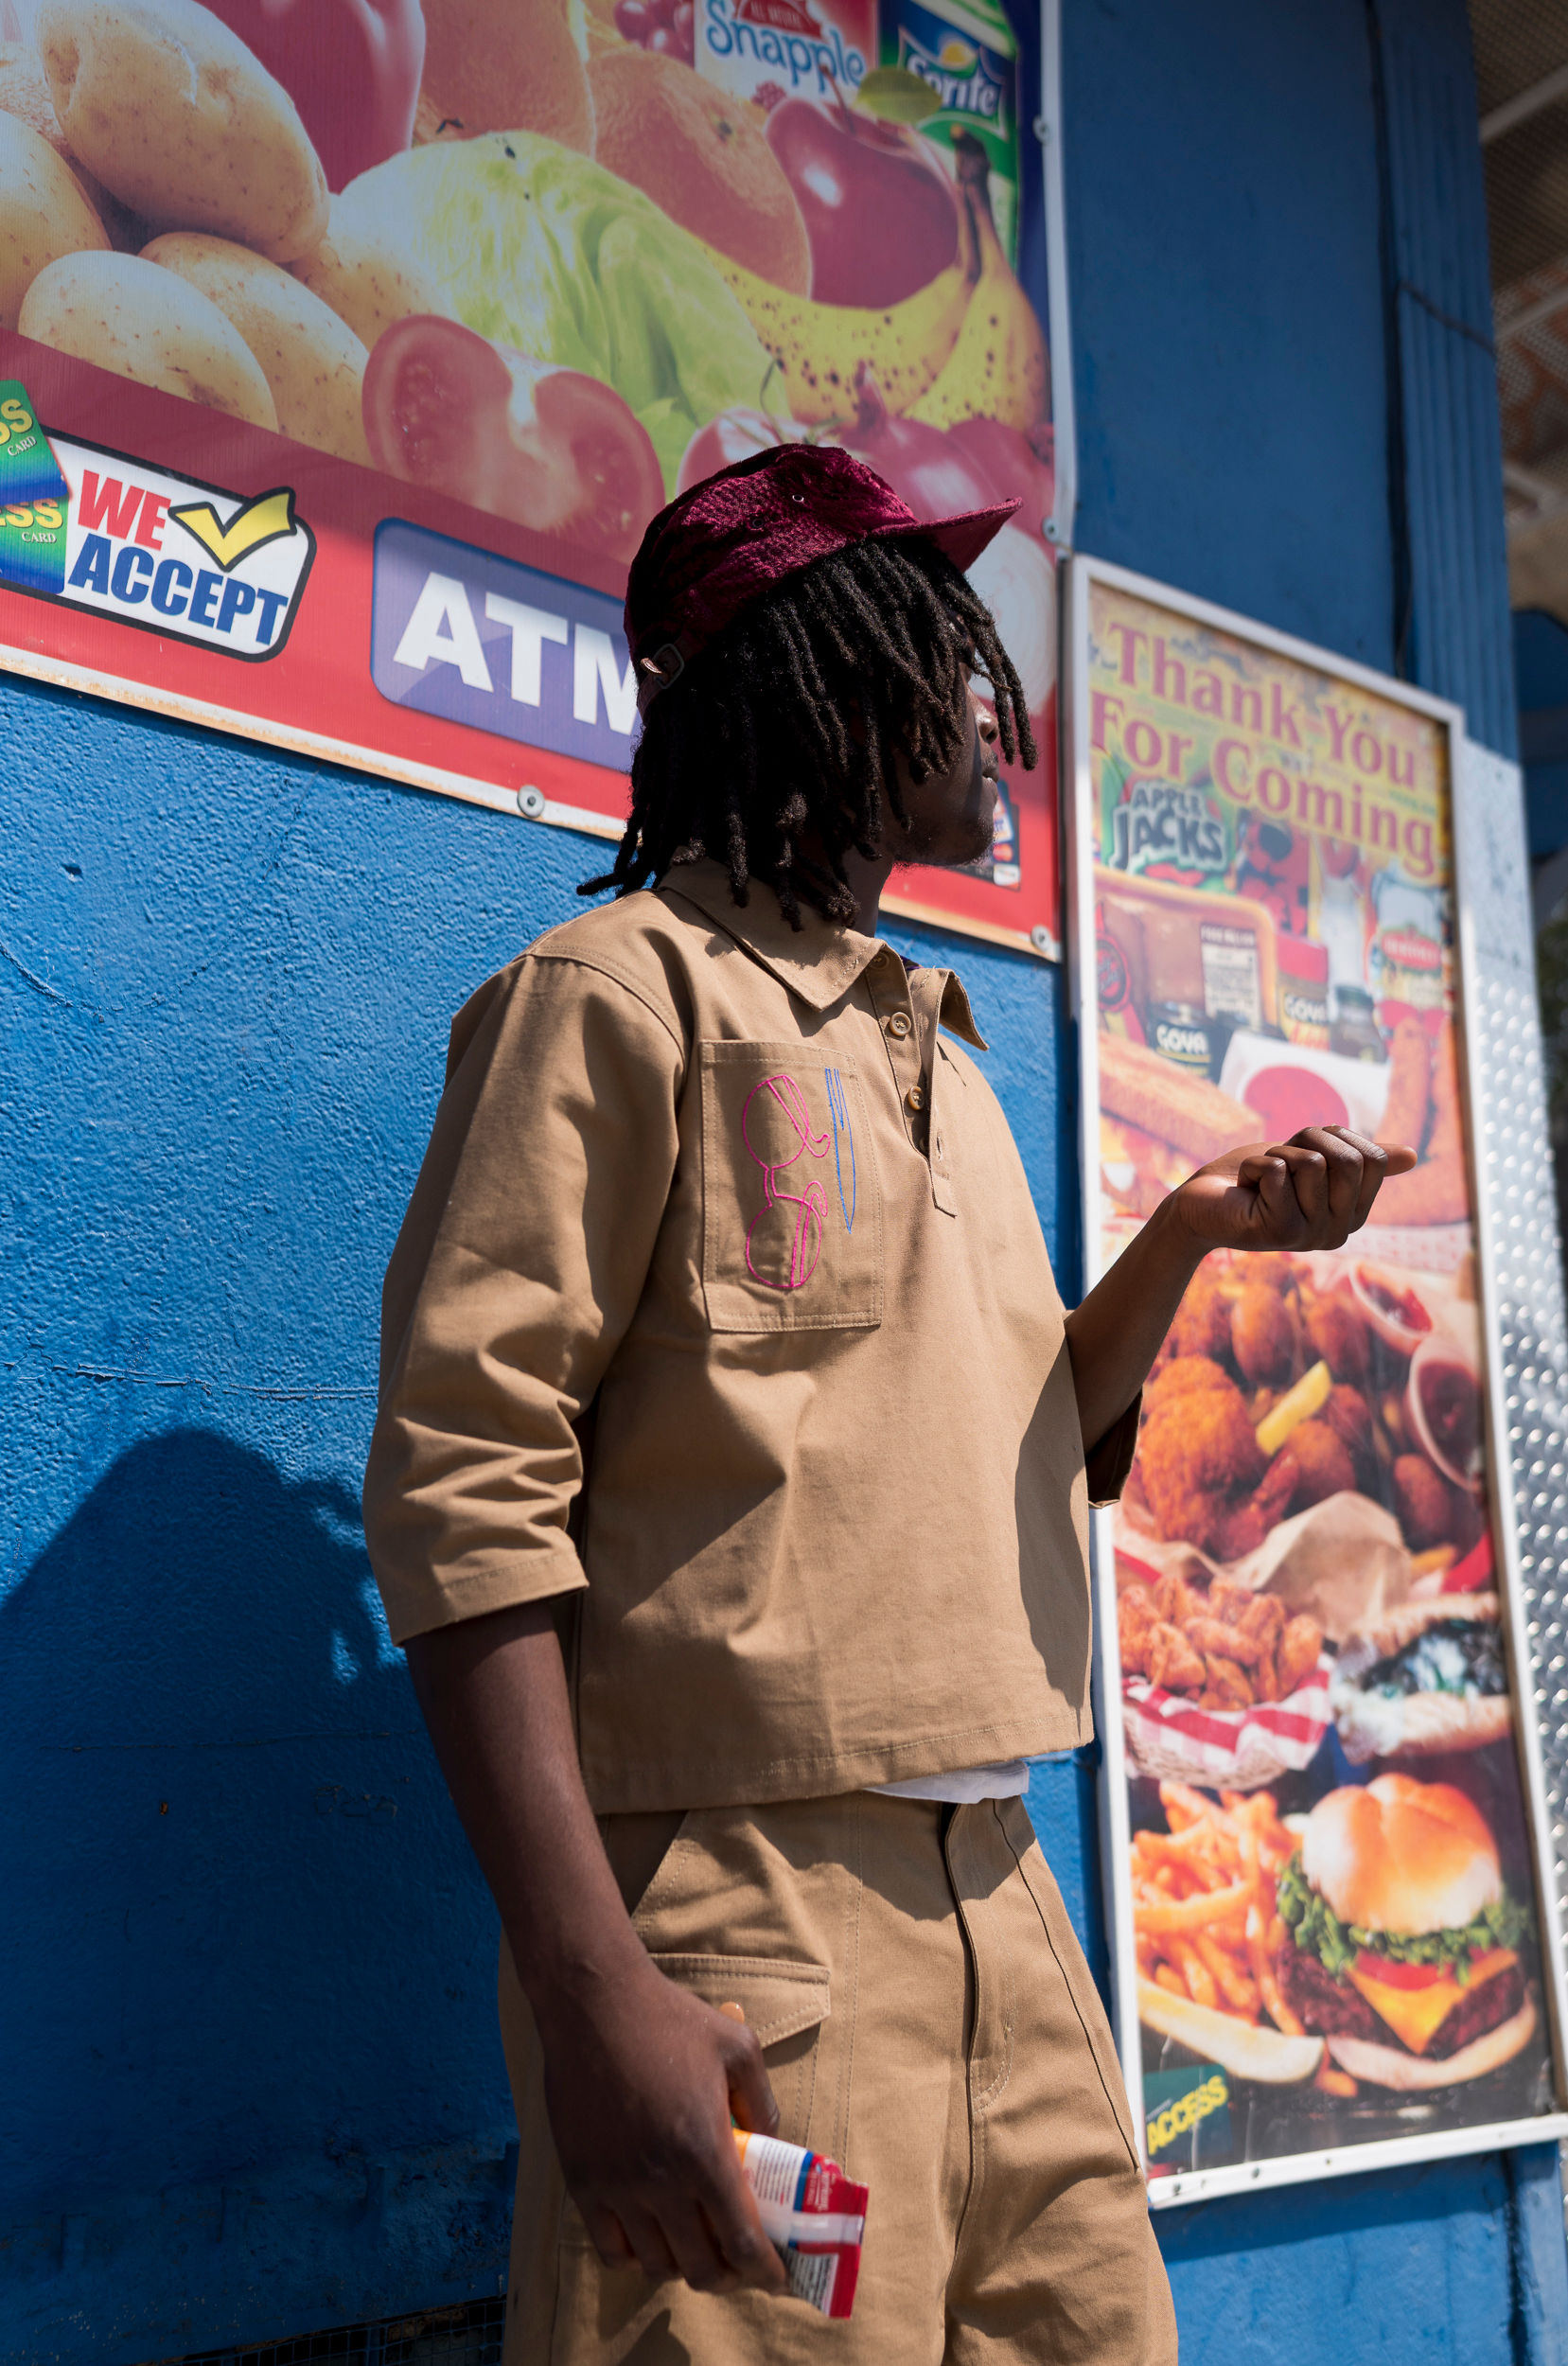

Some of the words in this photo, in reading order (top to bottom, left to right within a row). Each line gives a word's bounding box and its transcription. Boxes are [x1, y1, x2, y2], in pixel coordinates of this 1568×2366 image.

[706, 0, 865, 93] Snapple
[8, 435, 37, 456] CARD
[0, 498, 63, 529] SS
[22, 532, 57, 544] CARD
[78, 469, 171, 552] WE
[68, 533, 289, 645] ACCEPT
[393, 572, 640, 735] ATM
[1107, 622, 1302, 749] Thank
[1323, 703, 1416, 791] You
[1090, 689, 1192, 778] For
[1213, 737, 1436, 878] Coming
[1134, 786, 1202, 818] APPLE
[1114, 808, 1223, 870] JACKS
[1147, 2075, 1227, 2156] ACCESS
